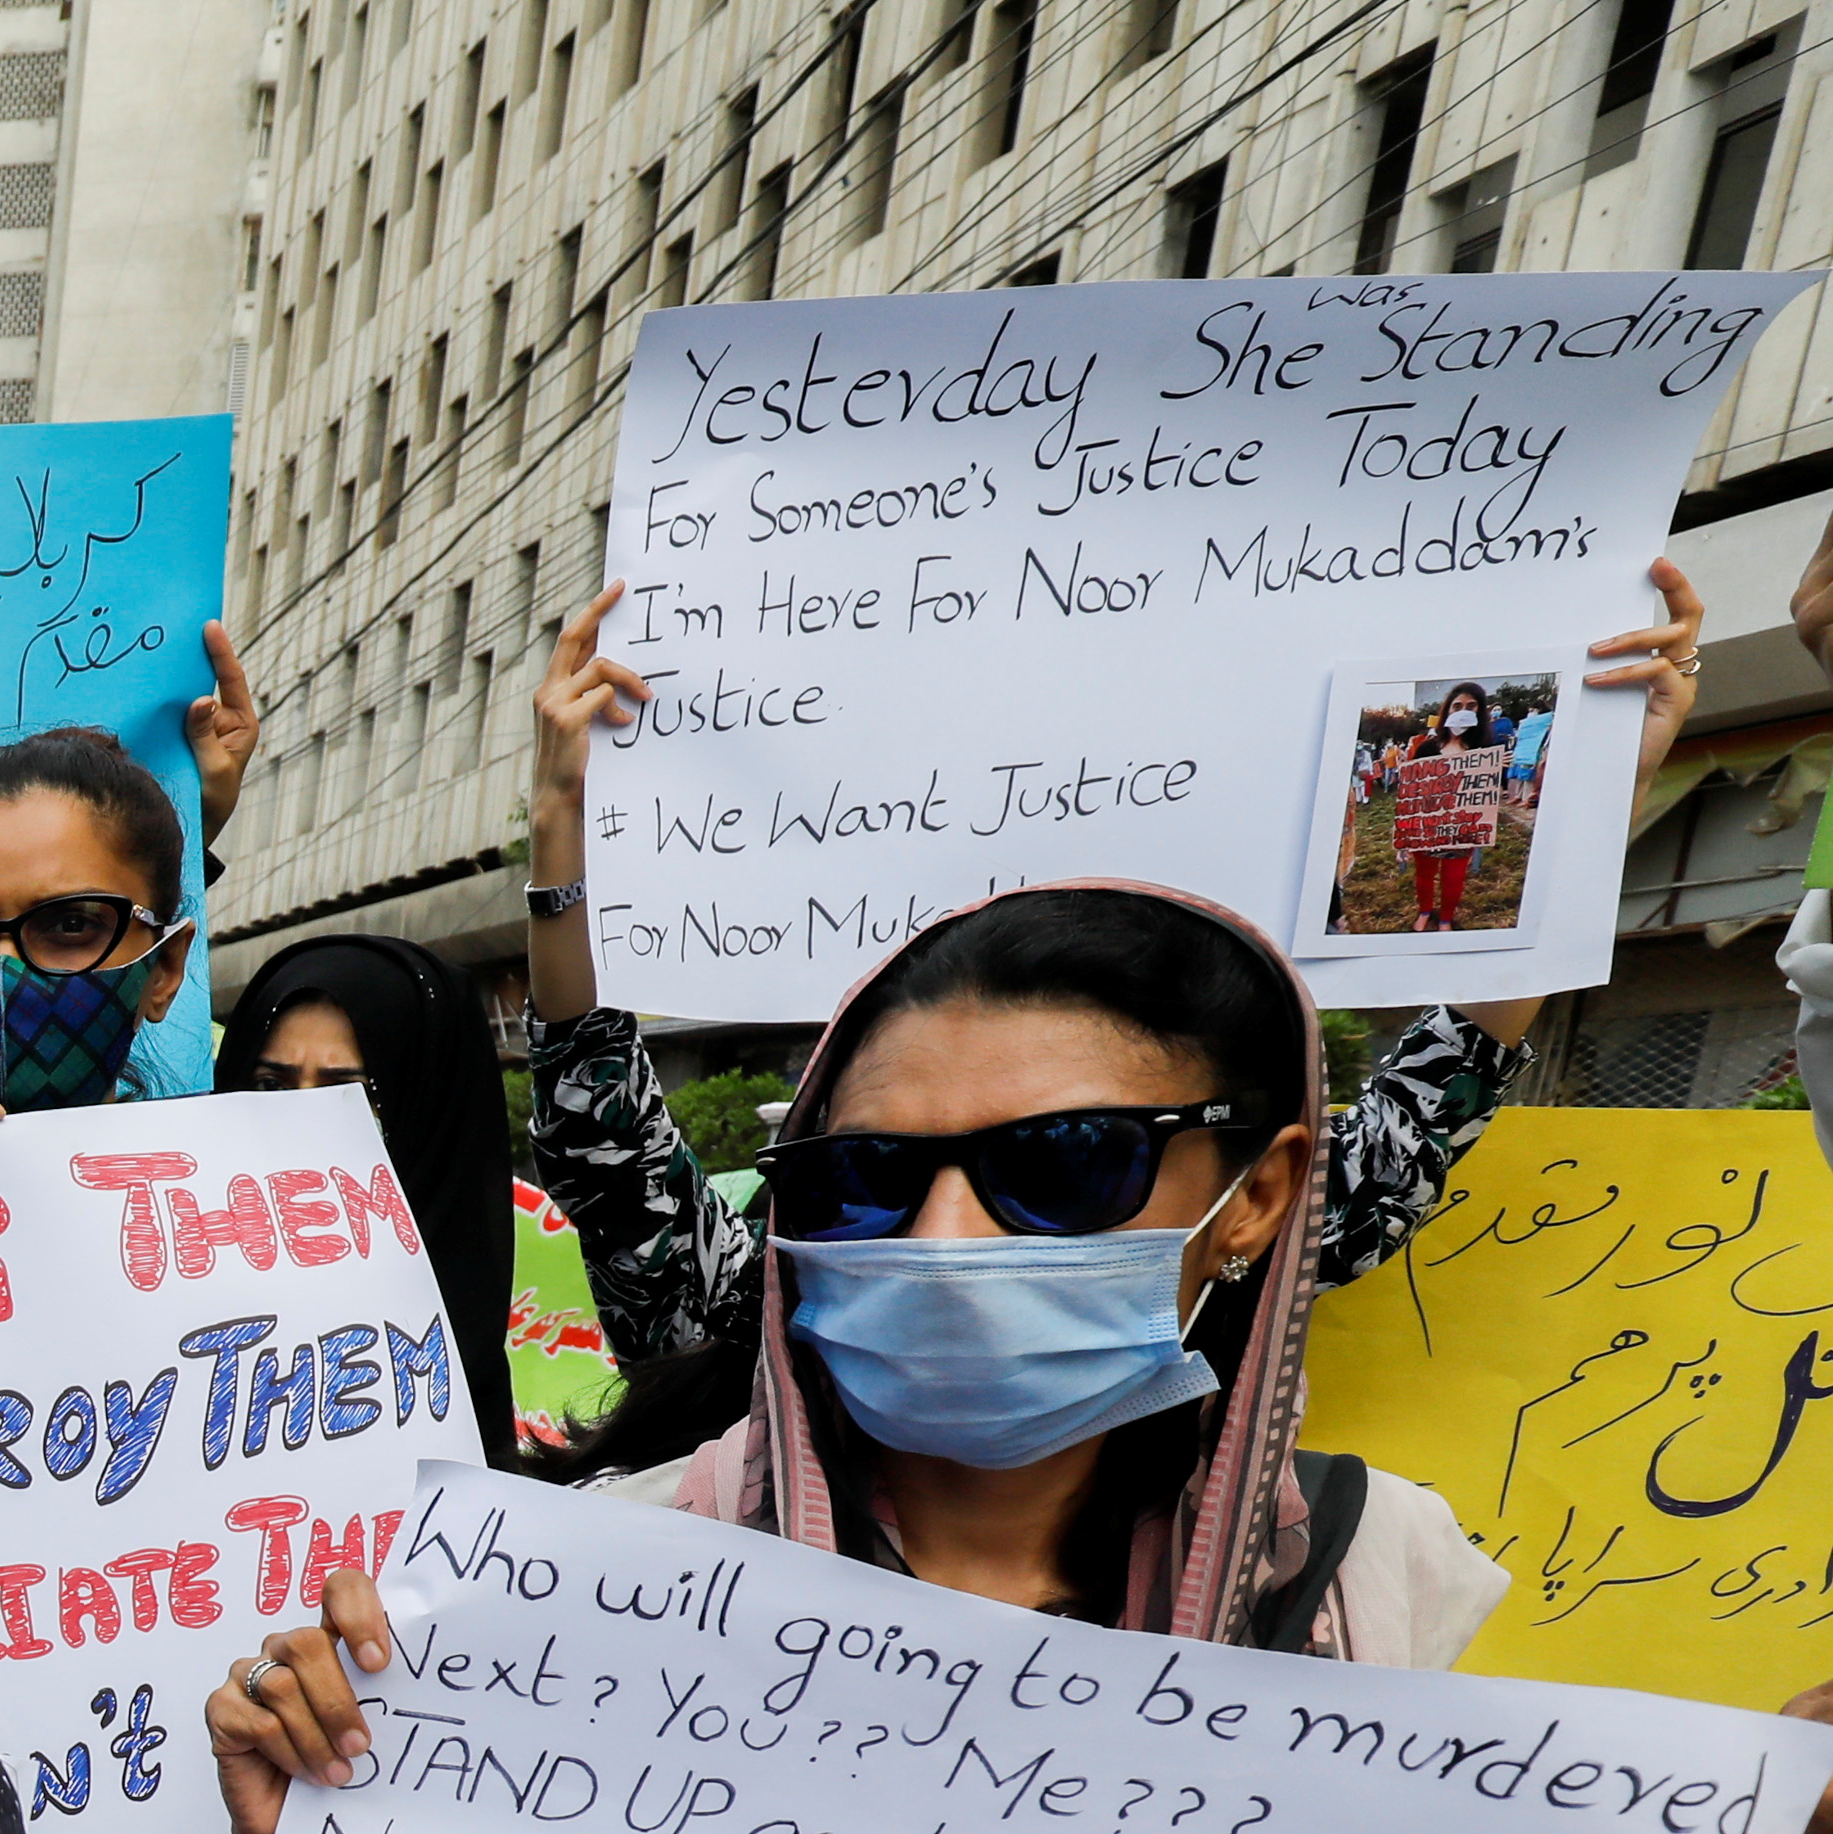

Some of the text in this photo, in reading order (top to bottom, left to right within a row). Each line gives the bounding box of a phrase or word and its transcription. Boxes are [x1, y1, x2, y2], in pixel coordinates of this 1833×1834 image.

[652, 275, 1765, 471] Yesterday She Standing
[643, 394, 1566, 553] For Someone's Justice Today
[629, 500, 1599, 645] I'm Here For Noor Mukaddam's
[655, 797, 746, 855] We
[769, 769, 950, 847] Want
[971, 758, 1197, 838] Justice
[599, 904, 668, 970] For
[681, 901, 793, 962] Noor
[69, 1151, 421, 1293] THEM
[179, 1313, 453, 1472] THEM
[404, 1486, 561, 1602] Who
[594, 1561, 748, 1640] will
[761, 1616, 986, 1744] going
[1010, 1634, 1101, 1711] to
[1136, 1652, 1248, 1741] be
[336, 1695, 599, 1824] STAND
